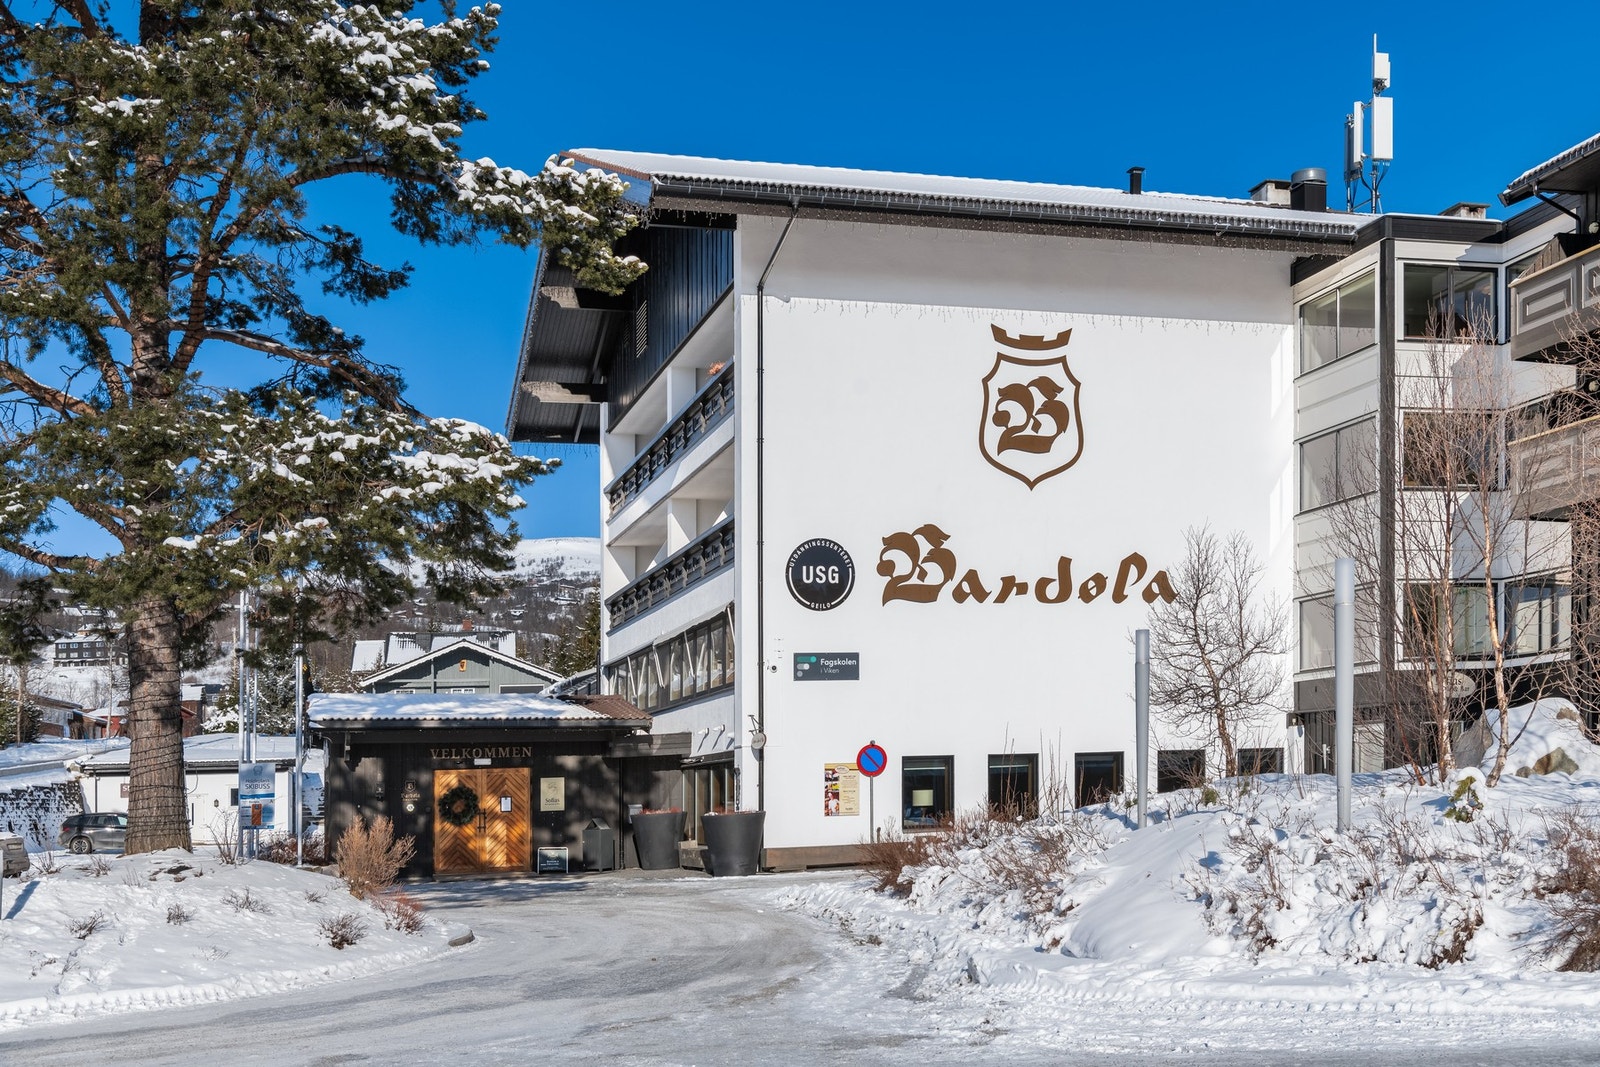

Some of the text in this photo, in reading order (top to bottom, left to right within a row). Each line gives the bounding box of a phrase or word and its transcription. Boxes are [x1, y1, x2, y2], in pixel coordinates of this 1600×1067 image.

[876, 523, 1180, 607] Bardøla
[802, 565, 839, 584] USG
[820, 658, 857, 668] Fagskolen
[430, 746, 533, 759] VELKOMMEN
